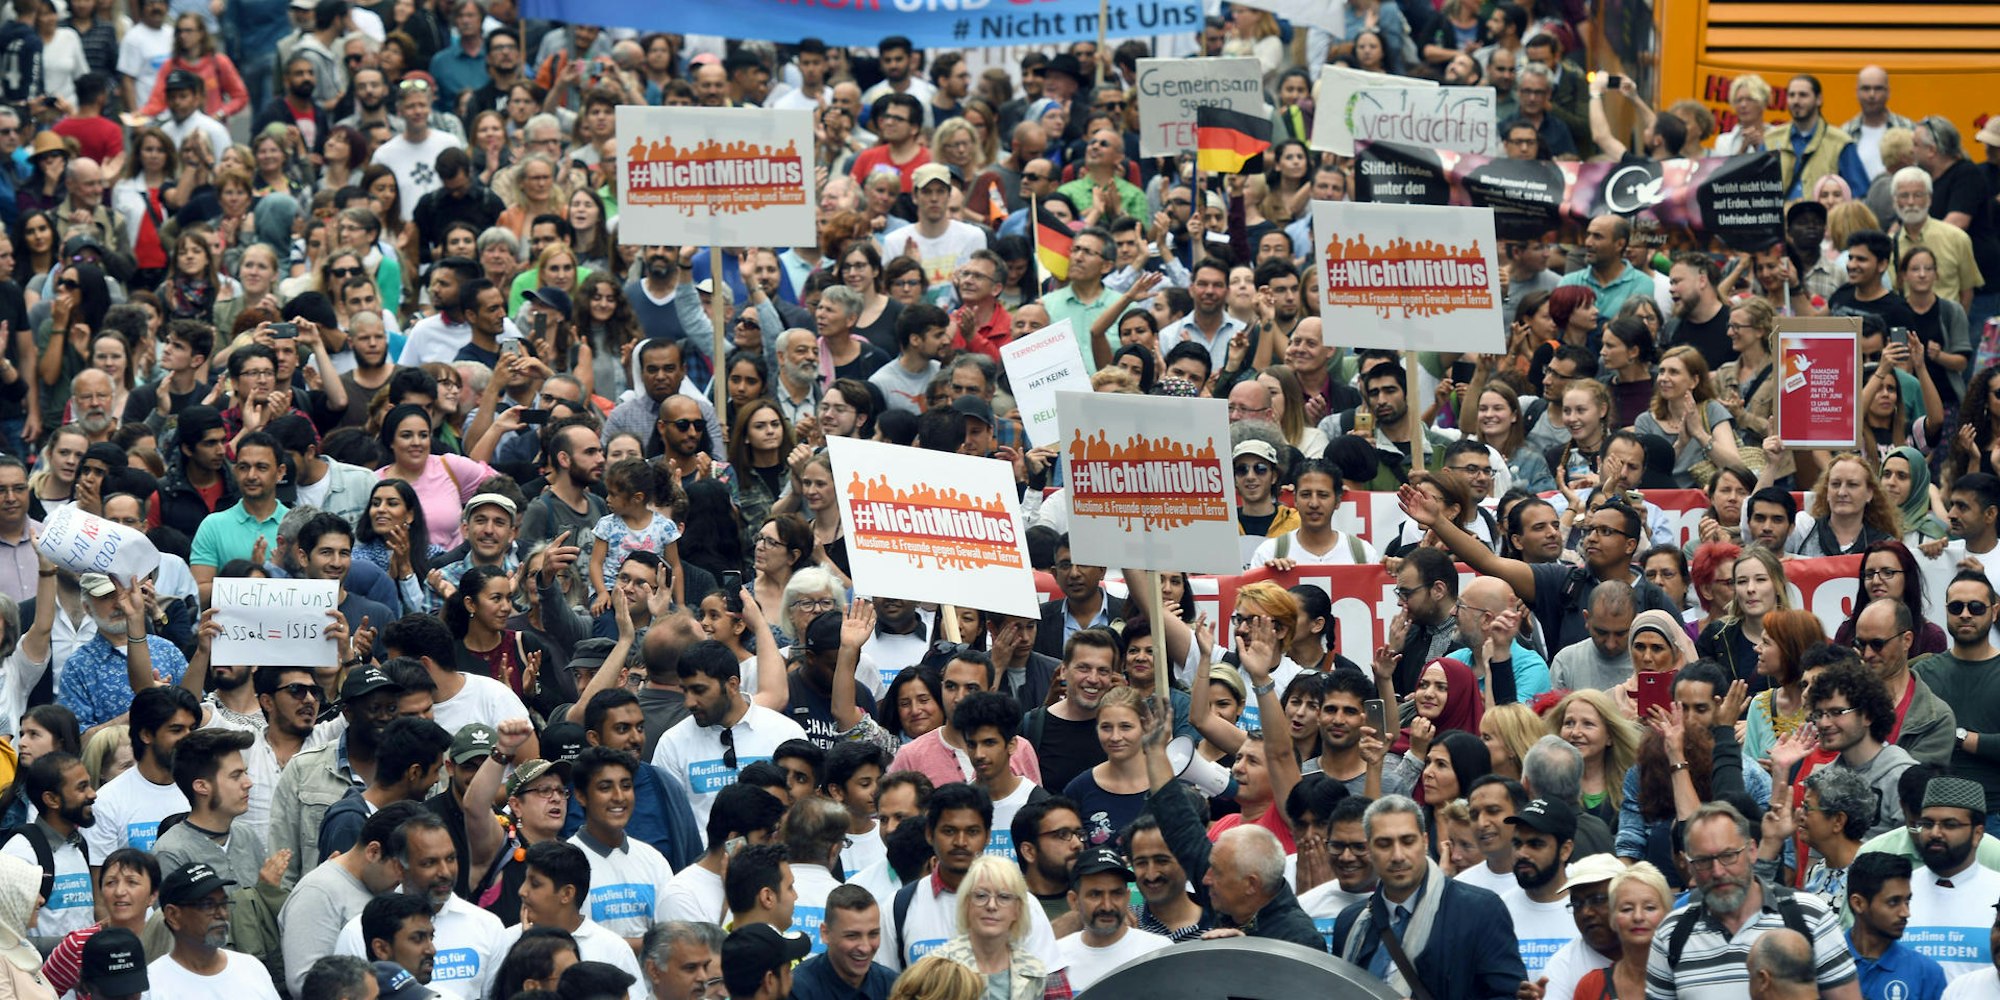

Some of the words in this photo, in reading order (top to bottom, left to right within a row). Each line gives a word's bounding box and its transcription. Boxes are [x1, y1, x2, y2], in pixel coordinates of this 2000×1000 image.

[981, 11, 1065, 39] Nicht
[1075, 5, 1128, 32] mit
[1137, 2, 1197, 27] Uns
[1140, 68, 1258, 97] Gemeinsam
[1361, 102, 1489, 155] verdächtig
[630, 158, 802, 188] #NichtMitUns
[1361, 160, 1397, 176] Stiftet
[672, 192, 705, 203] Freunde
[733, 191, 761, 202] Gewalt
[778, 191, 803, 201] Terror
[1373, 181, 1402, 196] unter
[1404, 181, 1426, 195] den
[1329, 259, 1487, 287] #NichtMitUns
[1330, 292, 1361, 303] Muslime
[1369, 292, 1399, 304] Freunde
[1401, 295, 1424, 307] gegen
[1425, 293, 1450, 304] Gewalt
[1451, 294, 1466, 304] und
[1467, 294, 1489, 304] Terror
[1011, 332, 1066, 359] TERRORISMUS
[1028, 377, 1045, 390] HAT
[1046, 368, 1070, 383] KEINE
[1073, 461, 1222, 493] #NichtMitUns
[1075, 500, 1103, 512] Muslime
[1104, 502, 1111, 512] &
[1111, 501, 1140, 514] Freunde
[1141, 504, 1163, 517] gegen
[1164, 502, 1188, 515] Gewalt
[1189, 503, 1203, 515] und
[1203, 503, 1226, 516] Terror
[853, 501, 1015, 543] #NichtMitUns
[62, 533, 90, 568] HAT
[856, 535, 889, 549] Muslime
[891, 539, 898, 549] &
[899, 538, 931, 552] Freunde
[932, 544, 956, 557] gegen
[956, 545, 982, 559] Gewalt
[983, 549, 997, 561] und
[997, 550, 1020, 563] Terror
[996, 834, 1008, 845] für
[805, 915, 822, 928] für
[1518, 941, 1557, 953] slime
[1949, 930, 1965, 942] für
[448, 952, 467, 963] für
